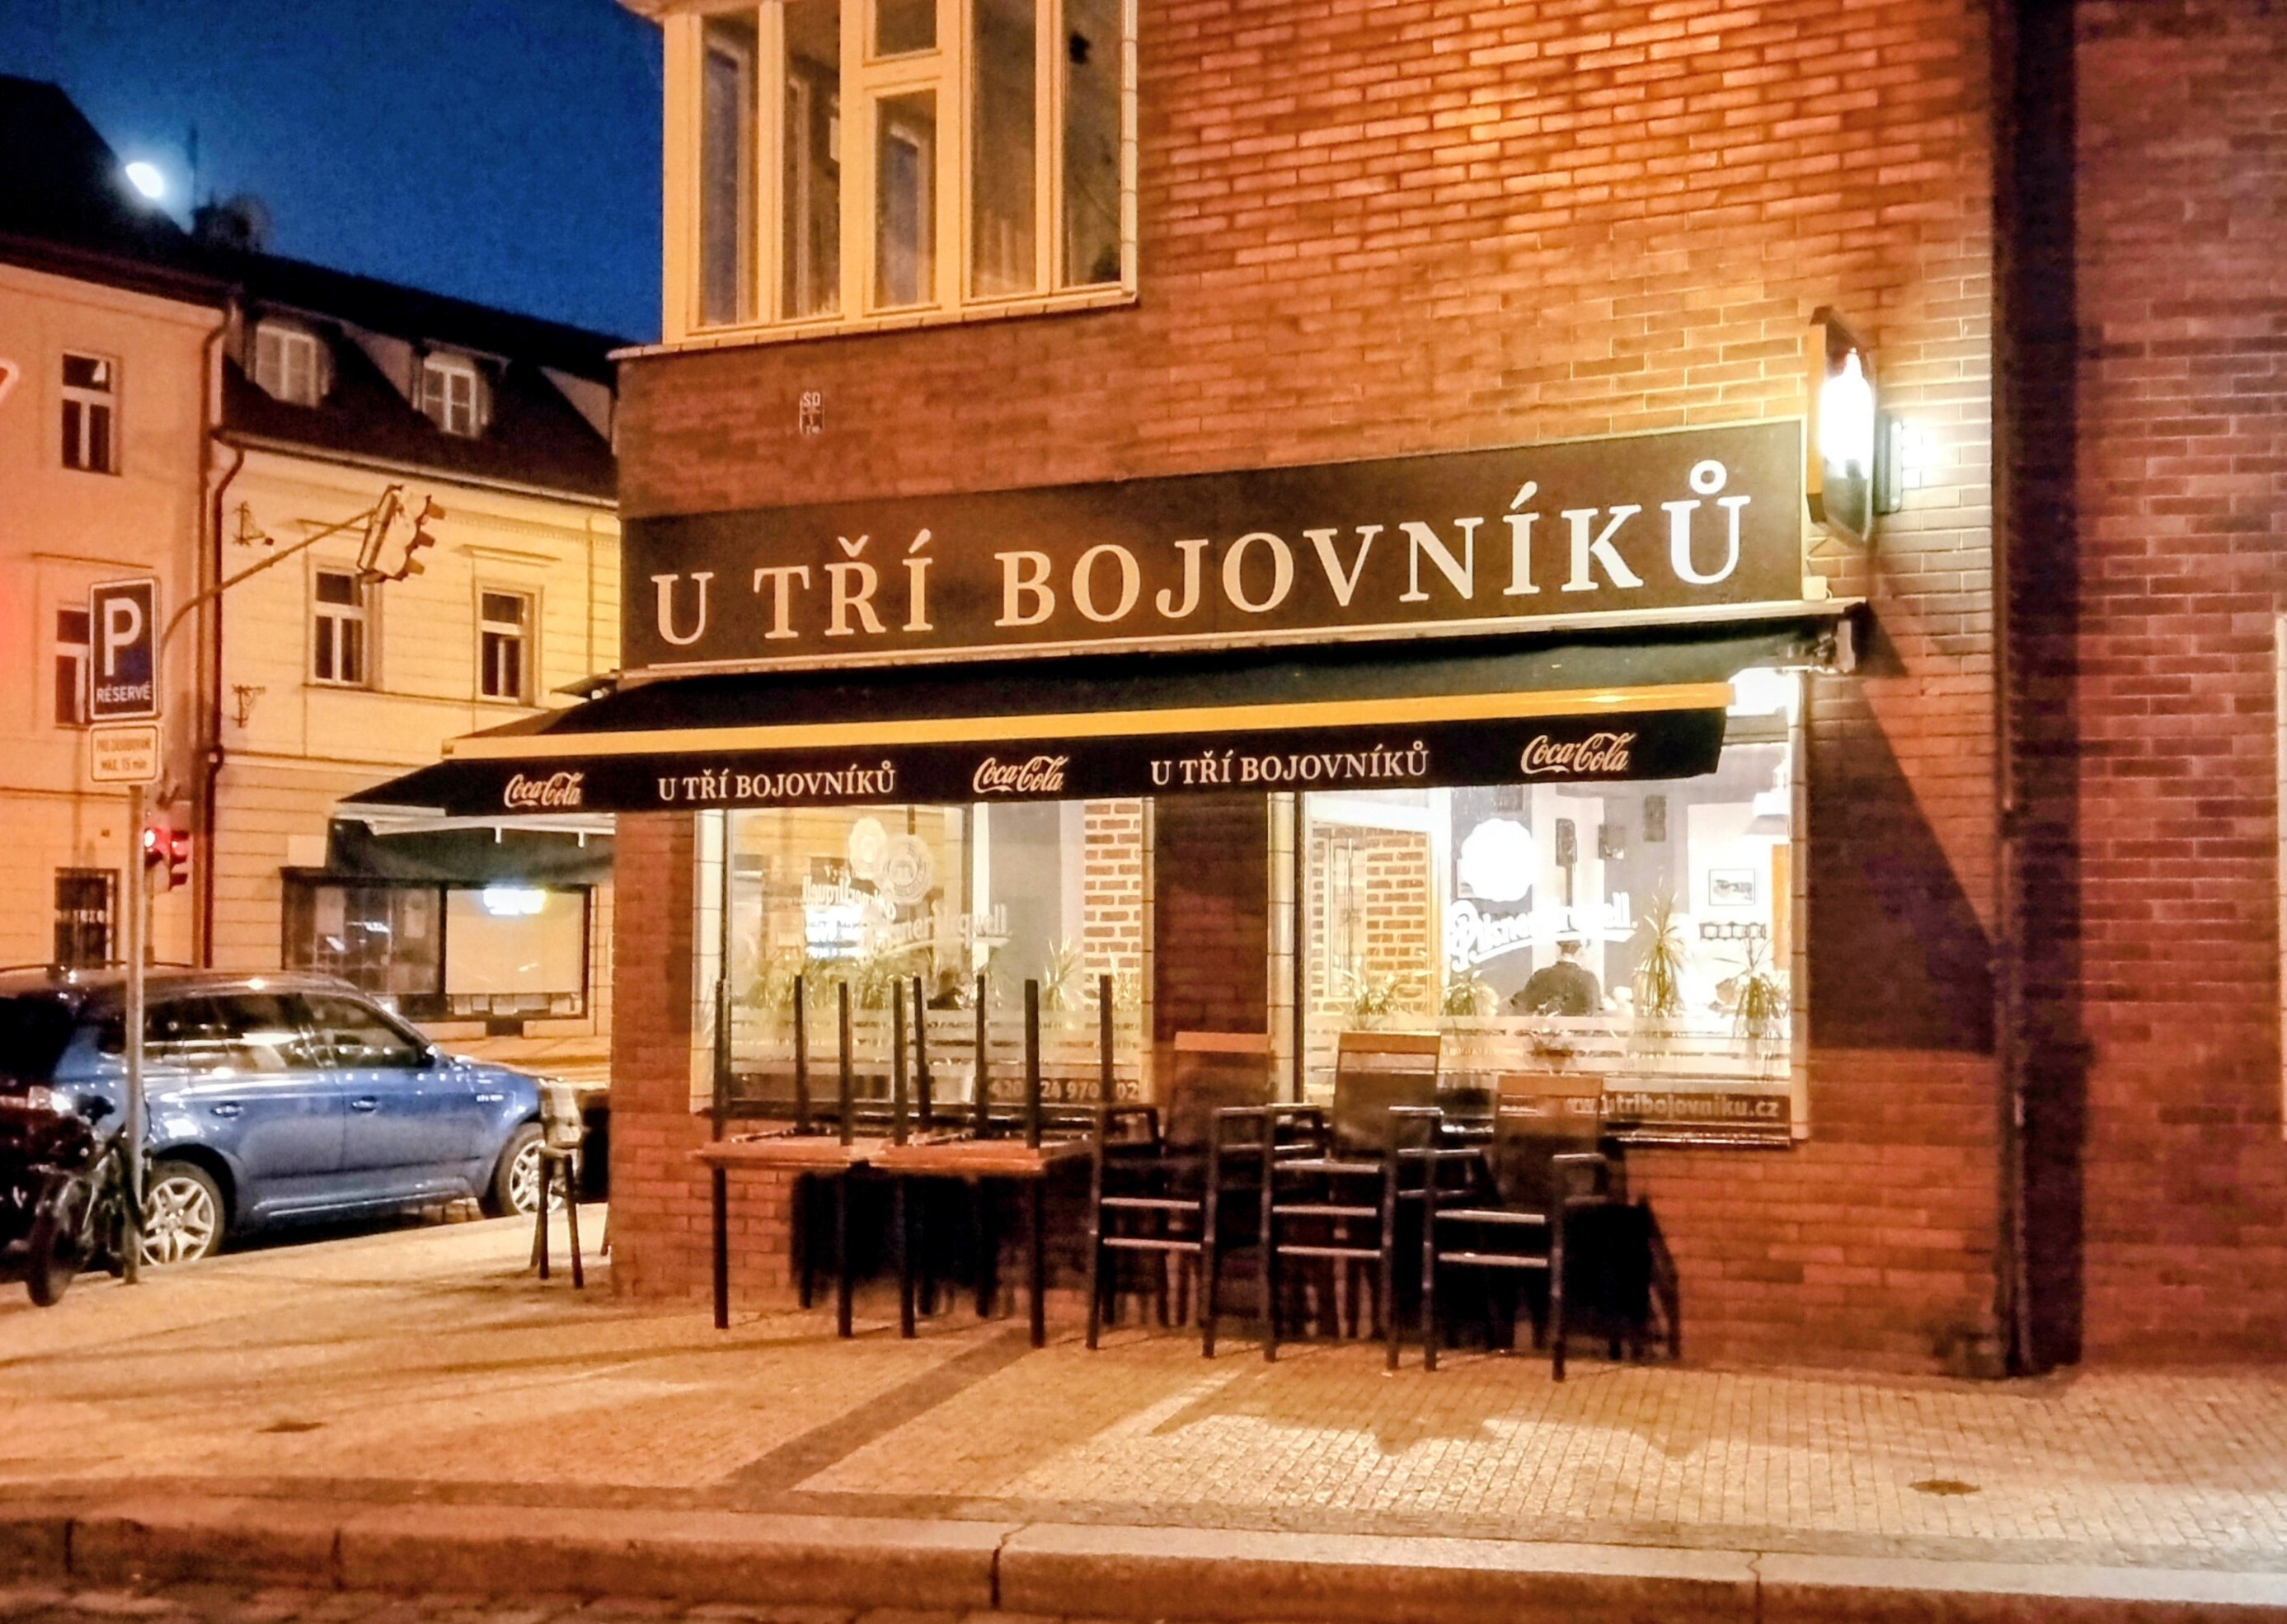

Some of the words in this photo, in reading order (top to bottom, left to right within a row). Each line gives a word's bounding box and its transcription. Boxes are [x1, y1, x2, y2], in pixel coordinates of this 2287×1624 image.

[651, 571, 714, 645] U
[754, 528, 933, 639] TŘÍ
[994, 460, 1752, 627] BOJOVNÍKŮ
[104, 597, 143, 677] P
[96, 683, 151, 703] RÉSERVÉ
[659, 777, 675, 800] U
[683, 768, 730, 800] TŘÍ
[735, 760, 895, 798] BOJOVNÍKŮ
[1150, 760, 1172, 786] U
[1179, 749, 1234, 785] TŘÍ
[1240, 740, 1429, 782] BOJOVNÍKŮ
